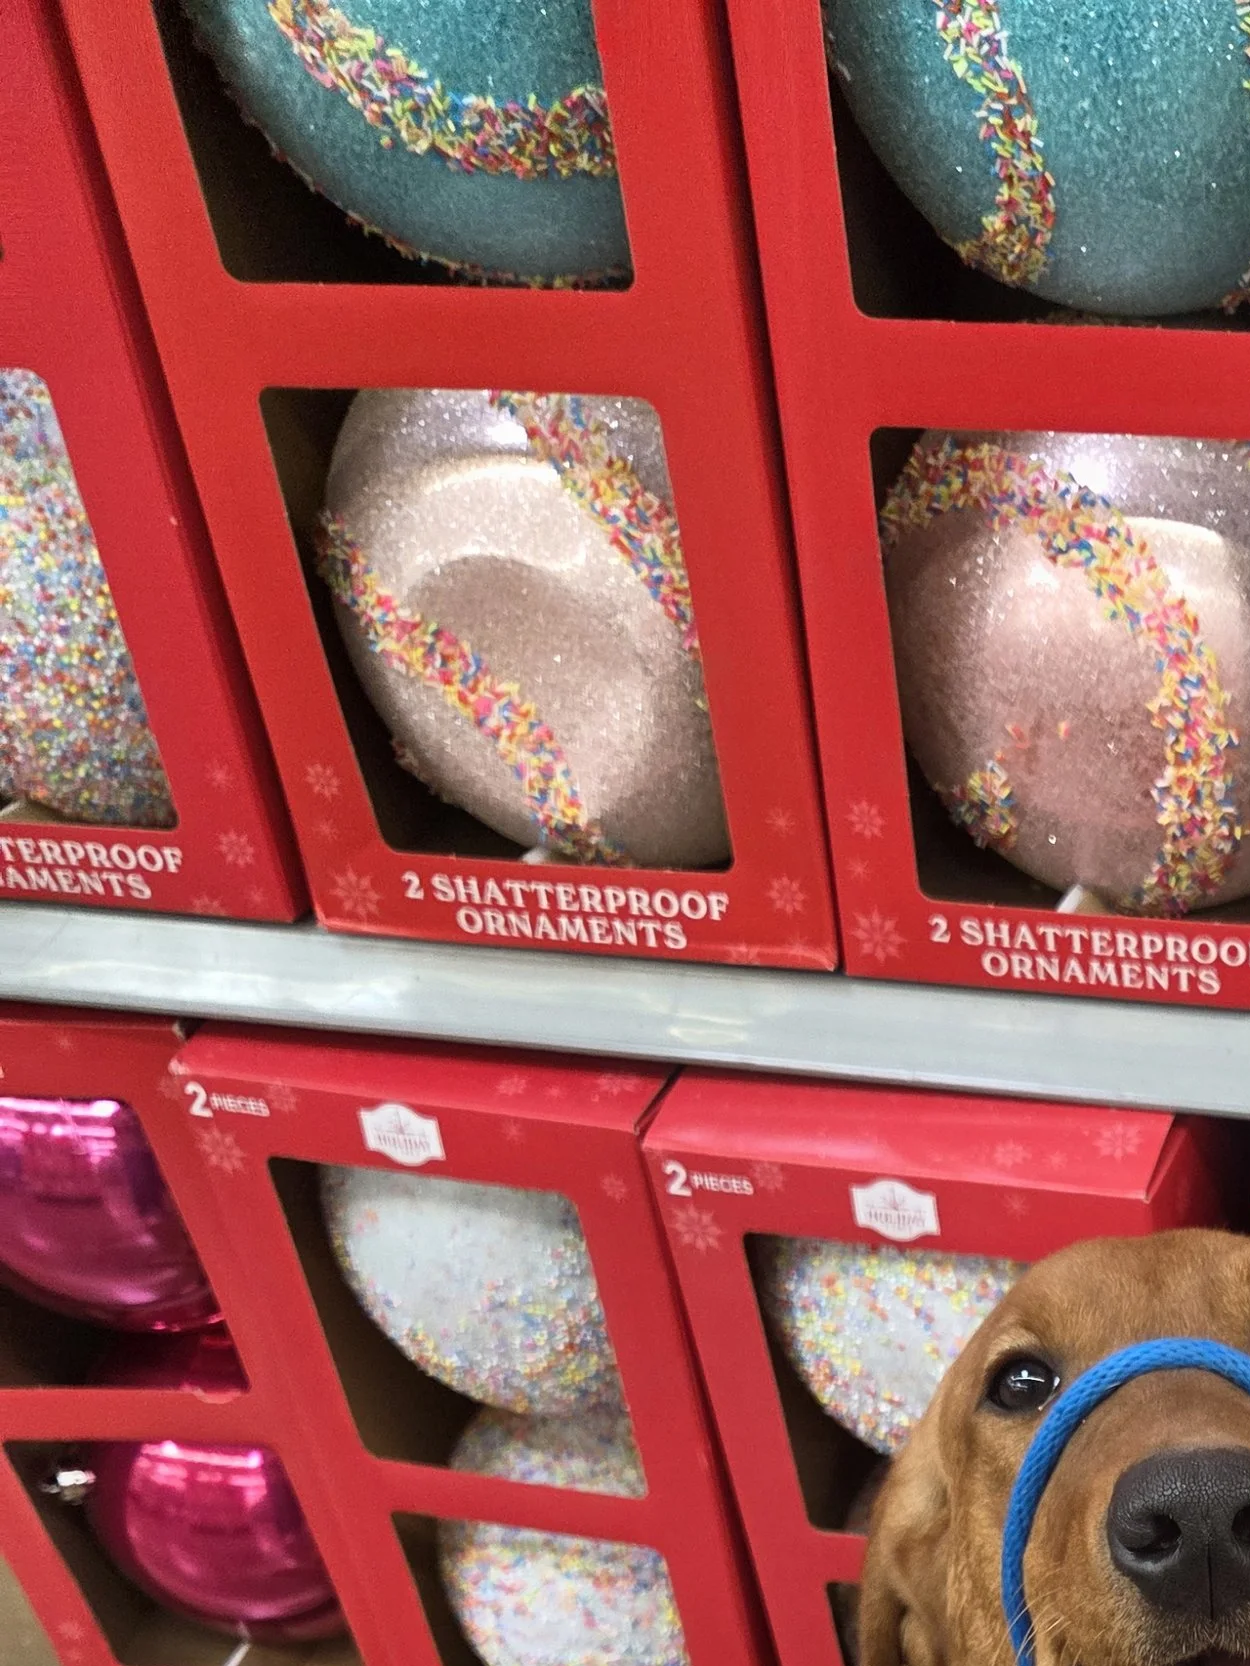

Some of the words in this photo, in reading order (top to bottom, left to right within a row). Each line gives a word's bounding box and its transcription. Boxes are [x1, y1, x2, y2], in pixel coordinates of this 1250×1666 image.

[0, 865, 152, 899] AMENTS
[401, 871, 424, 899] 2
[431, 873, 729, 921] SHATTERPROOF
[456, 906, 688, 950] ORNAMENTS
[928, 914, 950, 944] 2
[981, 951, 1221, 996] ORNAMENTS
[184, 1081, 213, 1117] 2
[663, 1159, 692, 1197] 2
[691, 1171, 754, 1195] PIECES
